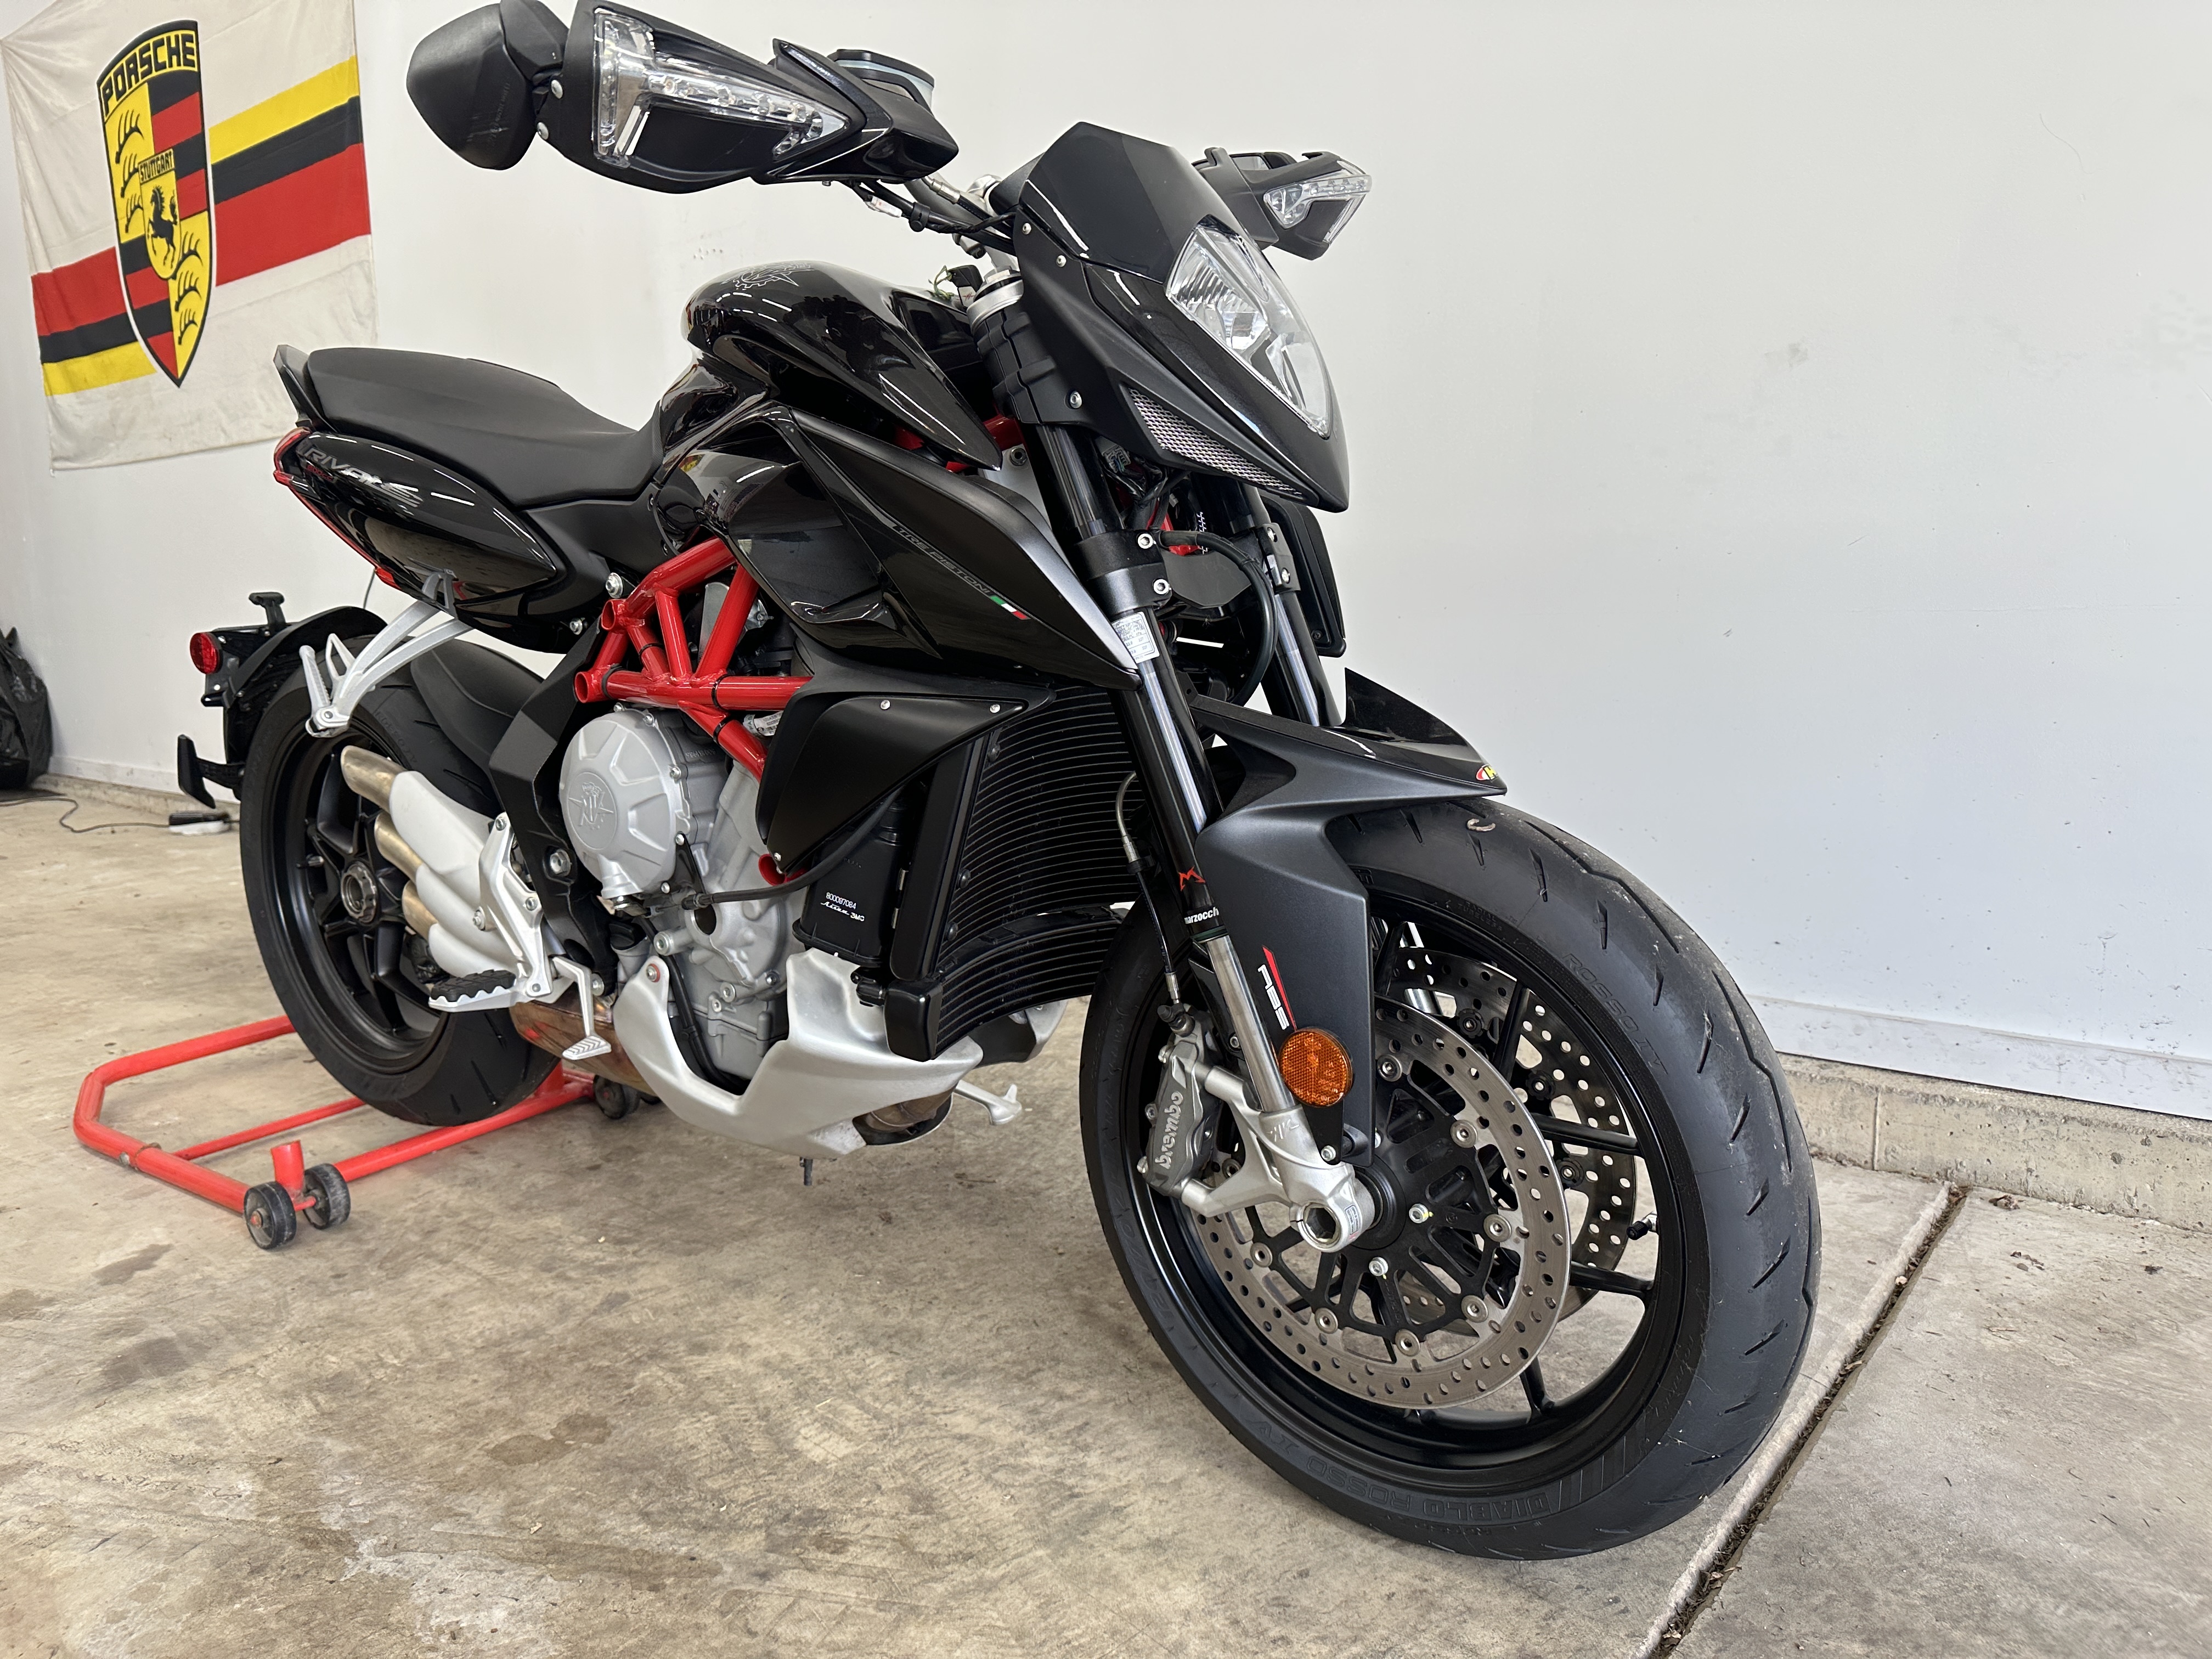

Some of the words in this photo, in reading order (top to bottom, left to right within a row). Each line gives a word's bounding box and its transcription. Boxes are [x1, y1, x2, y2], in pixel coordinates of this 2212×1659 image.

[101, 33, 195, 117] PORSCHE
[139, 151, 173, 182] STUTTGART
[899, 527, 930, 550] TRE
[929, 550, 991, 594] PISTONI
[1184, 906, 1220, 924] marzocch
[1257, 963, 1290, 1030] ABS
[1563, 952, 1639, 1033] ROSSO
[1154, 1090, 1184, 1170] brembo
[1306, 1454, 1412, 1512] ROSSO
[1423, 1492, 1551, 1522] DIABLO
